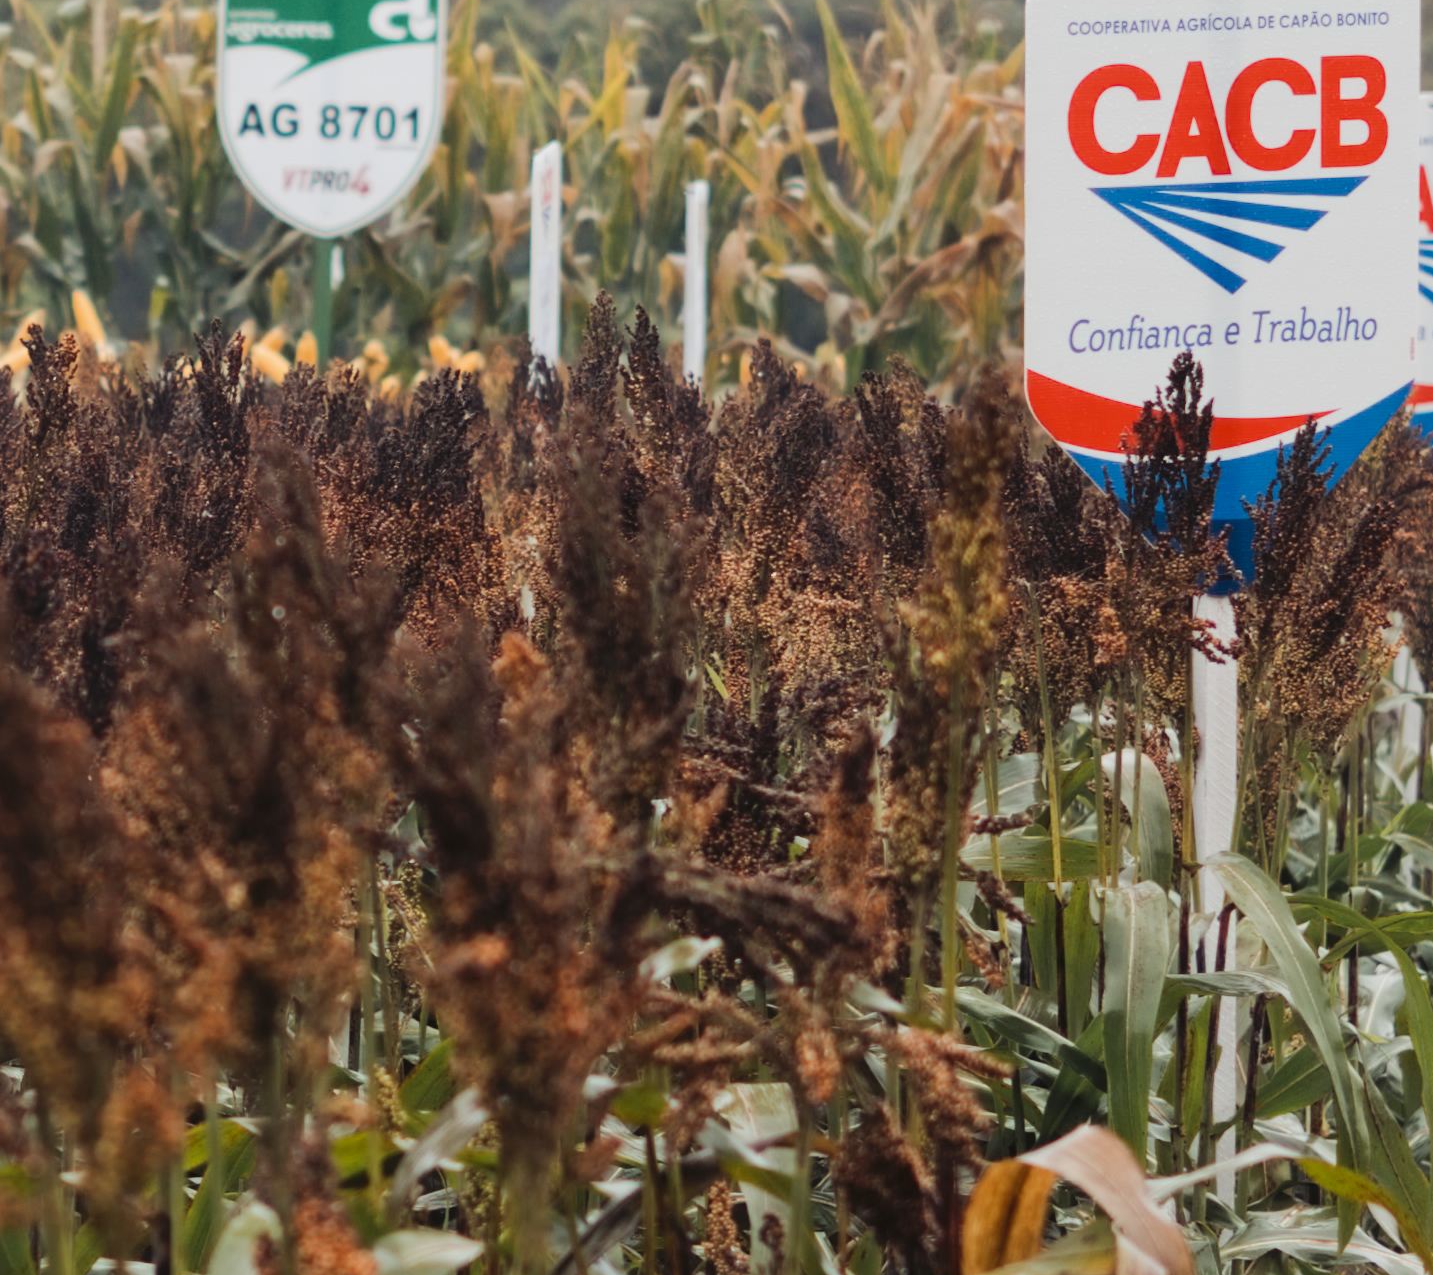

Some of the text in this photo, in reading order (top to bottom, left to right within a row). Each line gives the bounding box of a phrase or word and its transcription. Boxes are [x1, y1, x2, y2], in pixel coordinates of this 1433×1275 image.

[1067, 11, 1389, 36] COOPERATIVA AGRÍCOLA DE CAPÃO BONITO
[238, 103, 420, 142] AG 8701
[1067, 54, 1389, 178] CACB
[1069, 306, 1378, 353] Confiança e Trabalho
